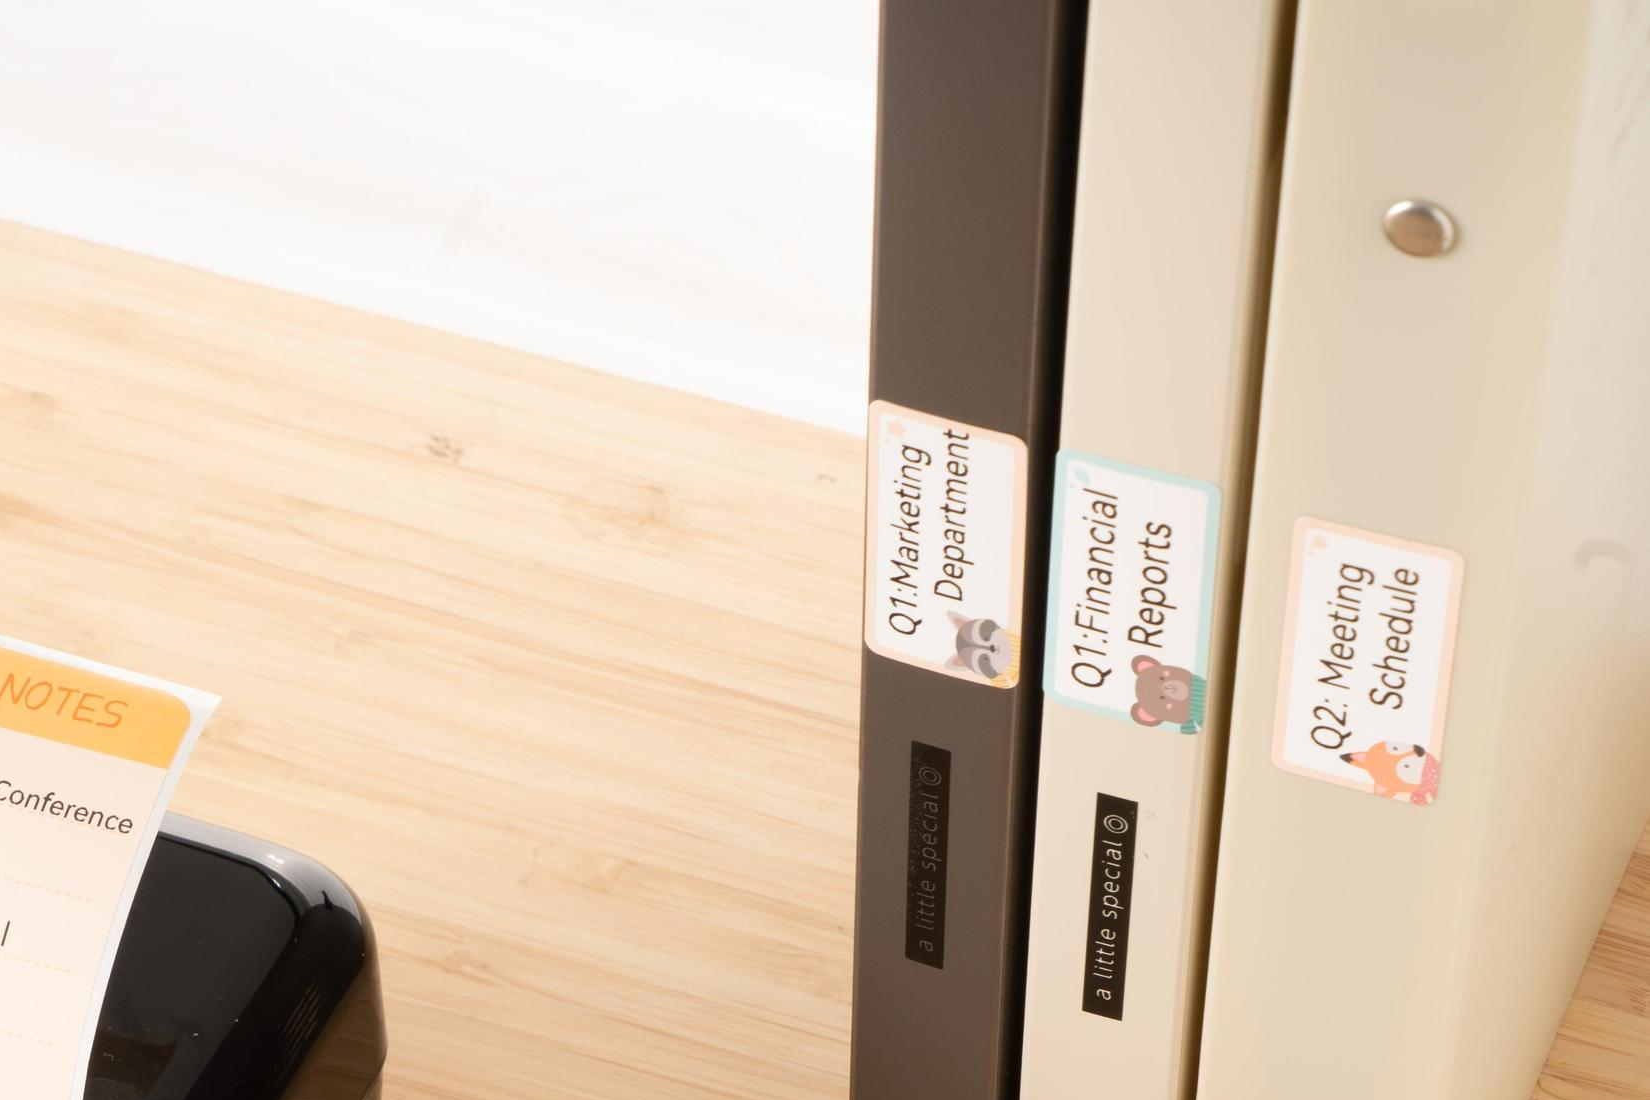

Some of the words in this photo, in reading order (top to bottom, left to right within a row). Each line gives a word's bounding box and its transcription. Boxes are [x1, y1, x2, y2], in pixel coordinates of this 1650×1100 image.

[888, 444, 932, 636] Q1:Marketing
[933, 428, 975, 602] Department
[1070, 487, 1118, 688] Q1:Financial
[1127, 521, 1177, 649] Reports
[1316, 562, 1376, 691] Meeting
[1368, 567, 1421, 711] Schedule
[1310, 699, 1353, 750] Q2:
[920, 792, 943, 872] special
[914, 879, 937, 931] little
[1101, 838, 1125, 921] special
[918, 938, 934, 953] a
[1091, 928, 1118, 980] little
[1095, 987, 1113, 1002] a
